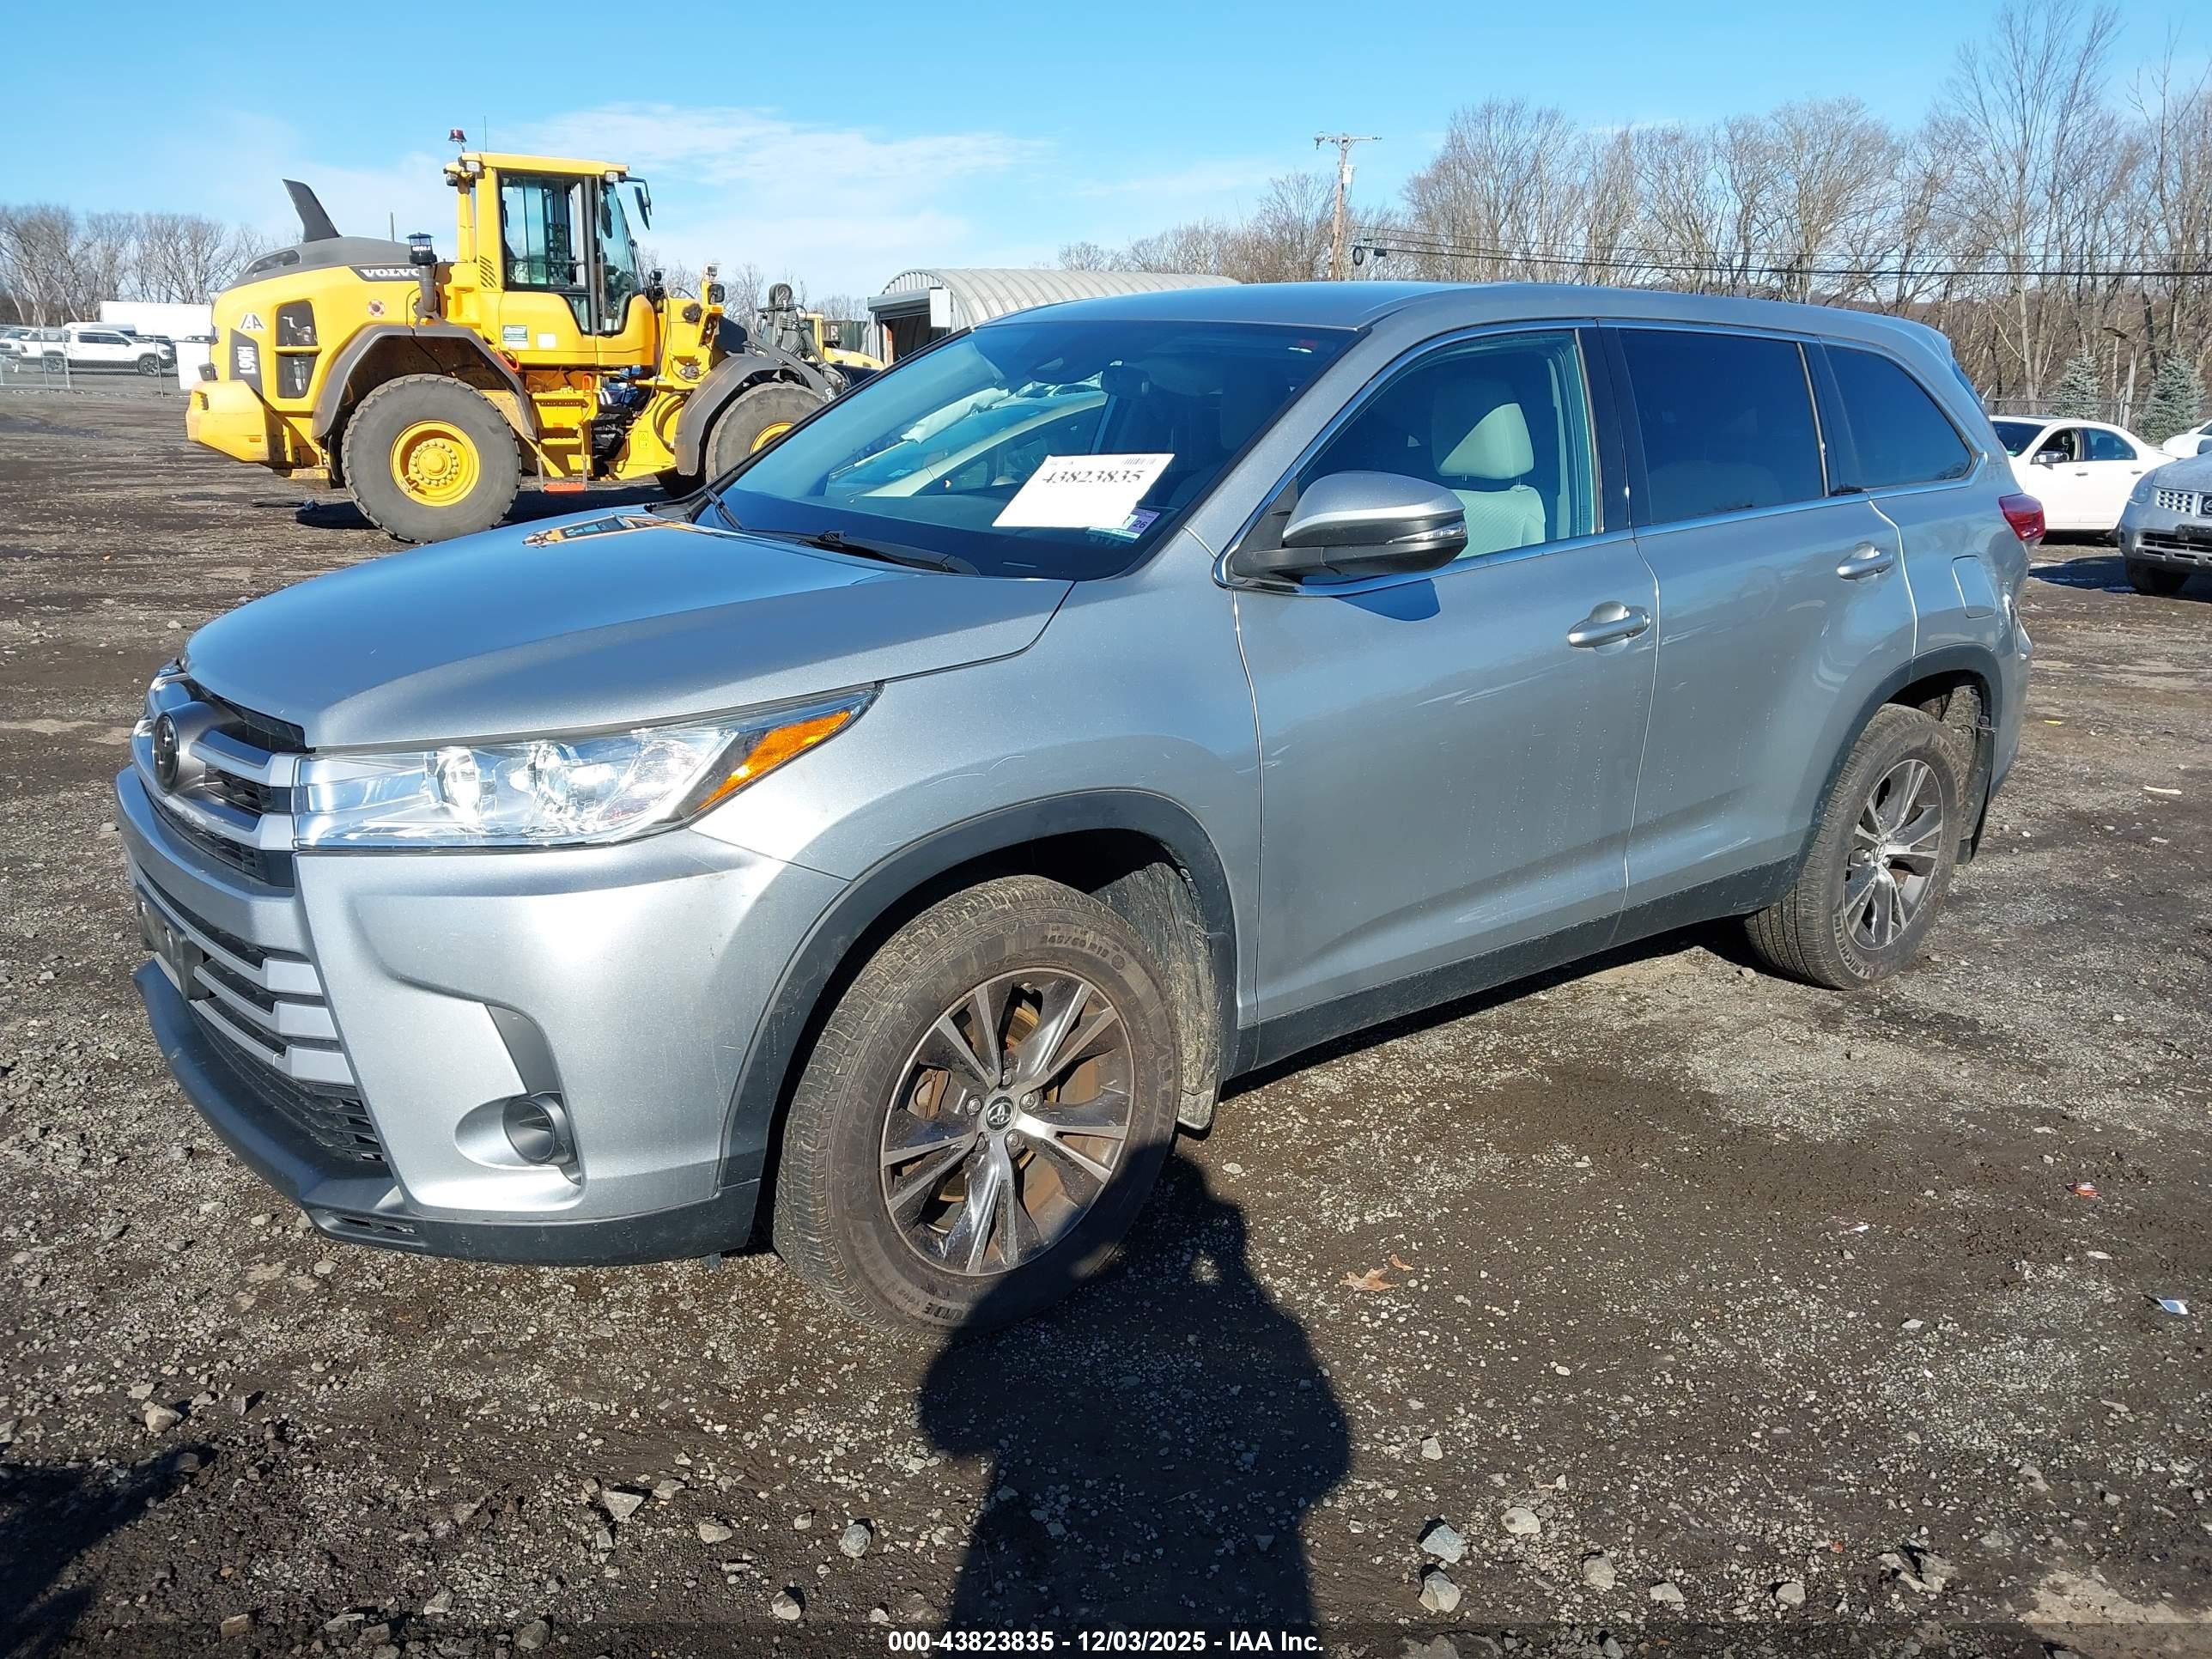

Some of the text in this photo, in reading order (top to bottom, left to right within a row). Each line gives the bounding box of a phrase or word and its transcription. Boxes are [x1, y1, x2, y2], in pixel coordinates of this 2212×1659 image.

[1042, 470, 1146, 483] 43823835
[1133, 520, 1148, 529] 26
[1833, 915, 1863, 974] MICHELIN
